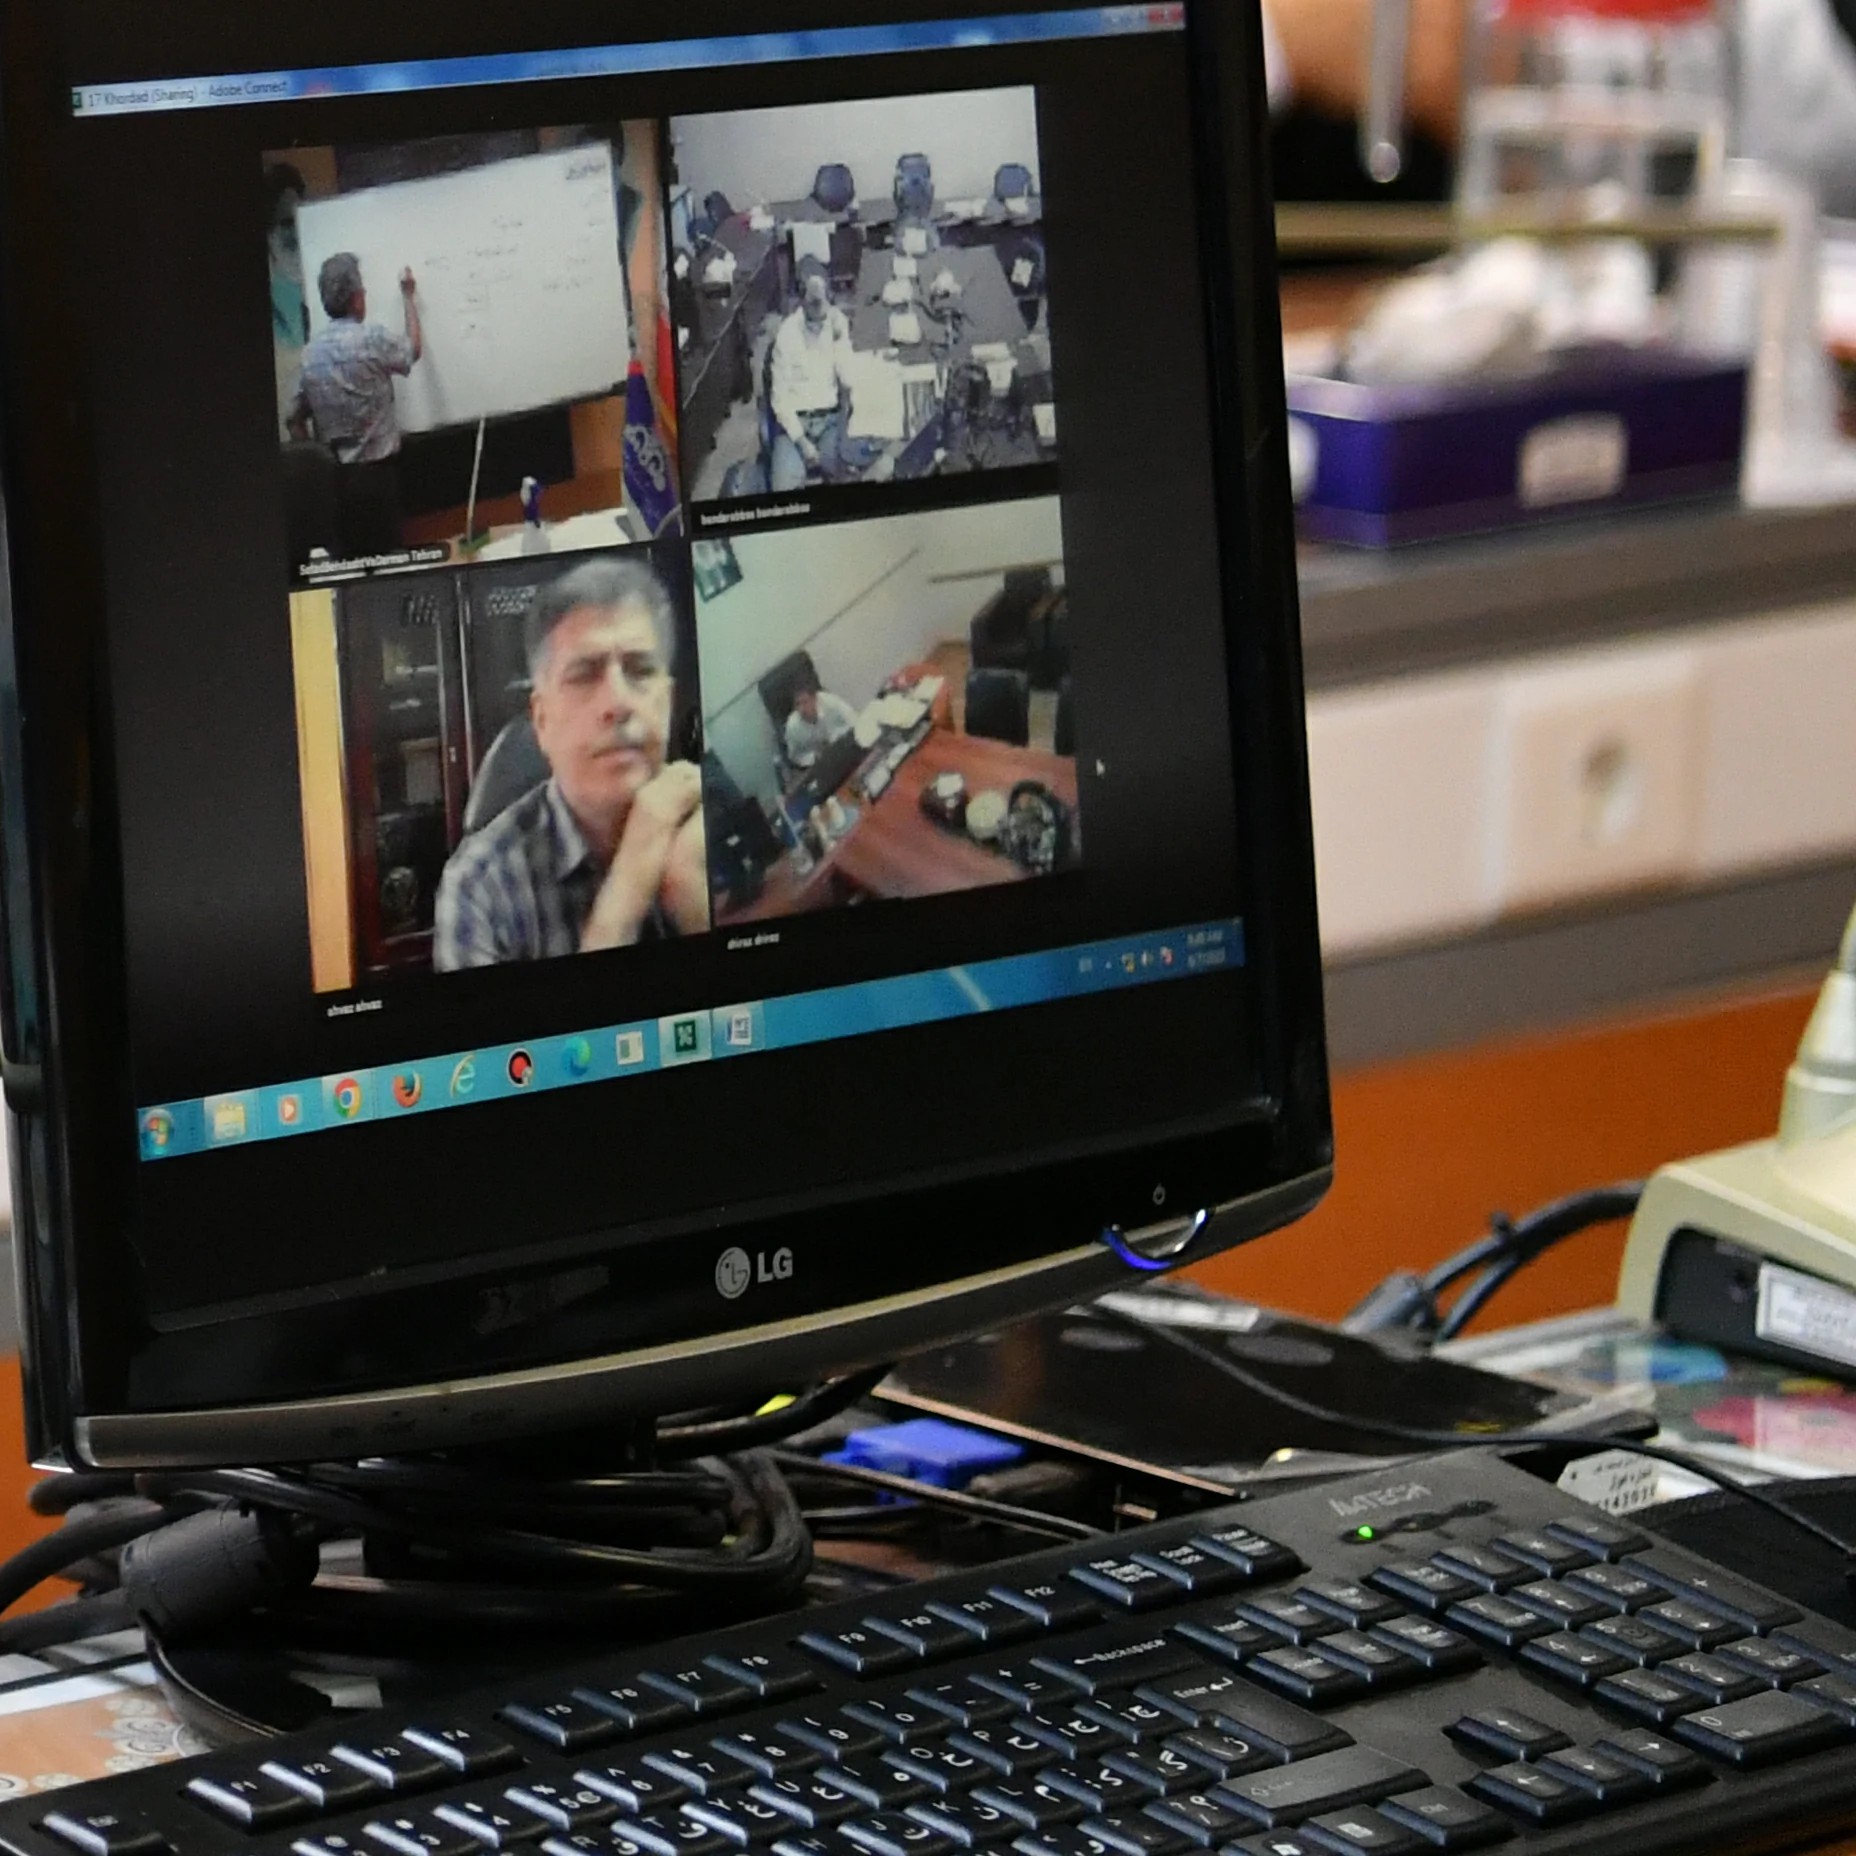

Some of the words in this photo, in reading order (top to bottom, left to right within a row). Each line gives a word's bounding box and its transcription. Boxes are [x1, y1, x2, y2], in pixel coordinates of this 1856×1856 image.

[208, 83, 243, 97] Adobe
[244, 80, 288, 95] Connect
[756, 1245, 794, 1284] LG
[962, 1600, 994, 1613] F11
[900, 1615, 933, 1629] F10
